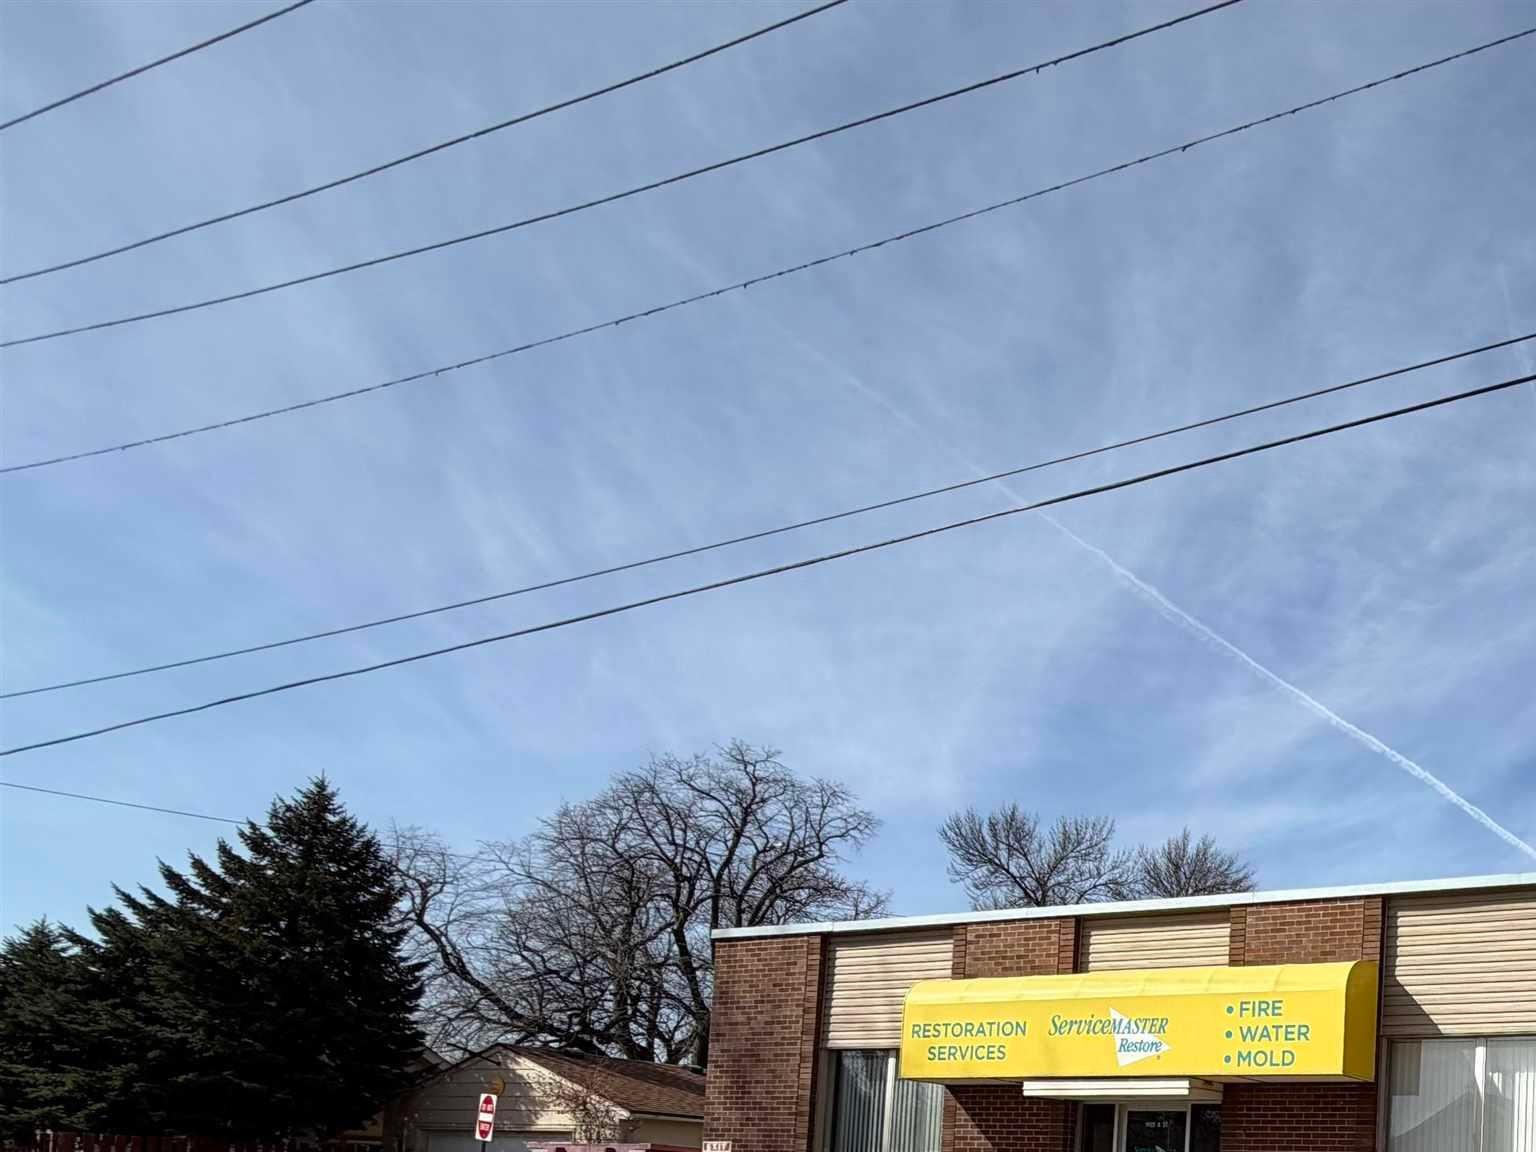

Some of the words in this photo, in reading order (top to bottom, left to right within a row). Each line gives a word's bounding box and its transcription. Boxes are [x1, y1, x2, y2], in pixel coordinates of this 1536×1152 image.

[1239, 1000, 1283, 1018] FIRE
[911, 1021, 1027, 1039] RESTORATION
[1048, 1014, 1169, 1036] ServiceMASTER
[1239, 1025, 1310, 1042] WATER
[927, 1045, 1007, 1061] SERVICES
[1118, 1038, 1163, 1053] Restore
[1236, 1050, 1295, 1067] MOLD
